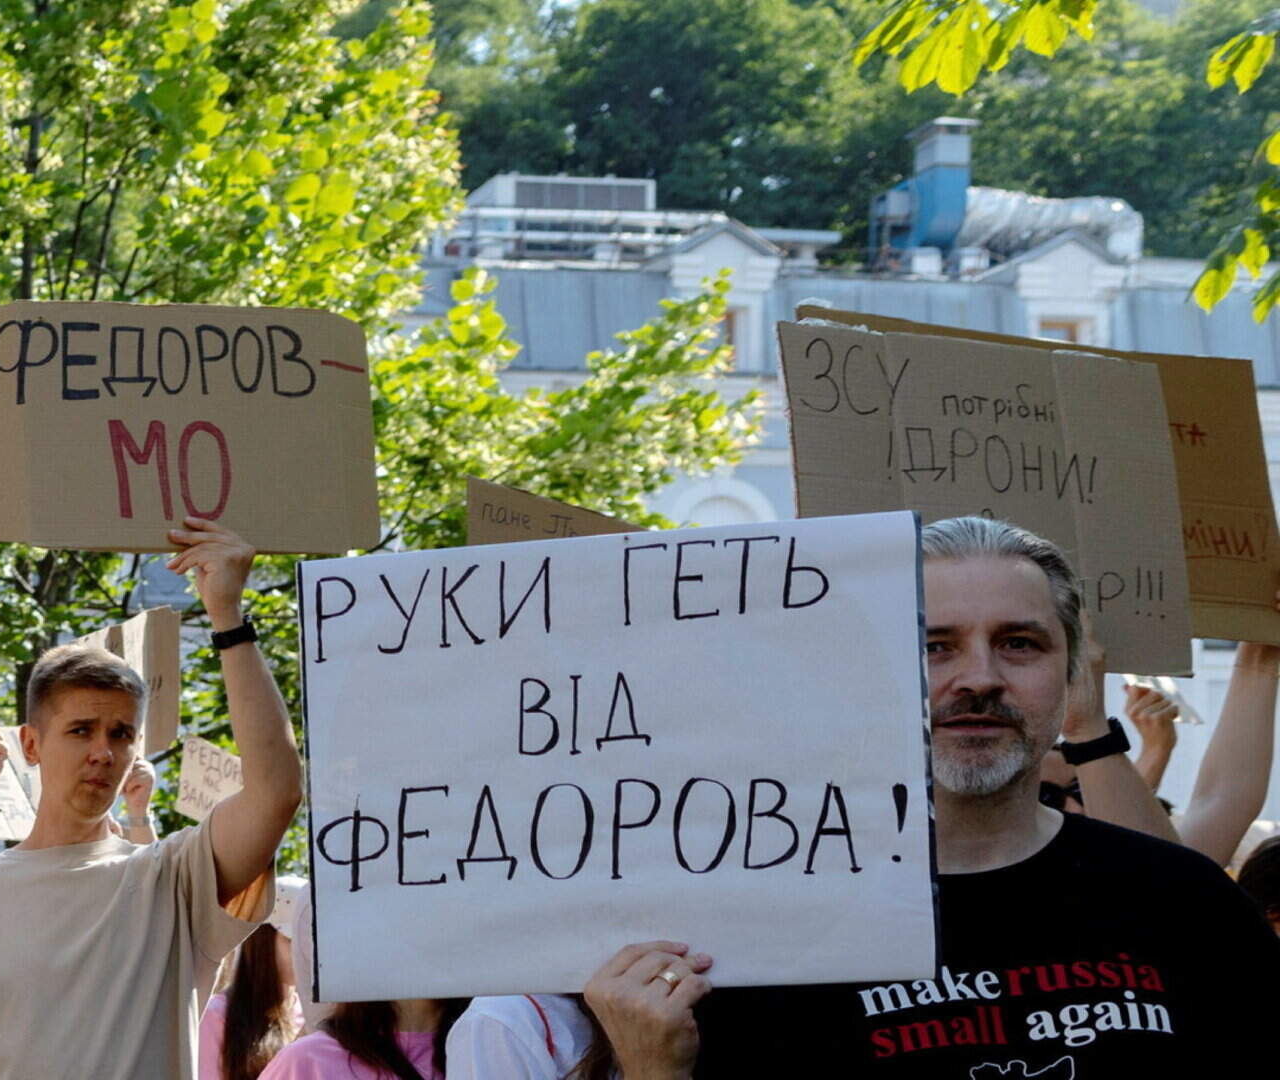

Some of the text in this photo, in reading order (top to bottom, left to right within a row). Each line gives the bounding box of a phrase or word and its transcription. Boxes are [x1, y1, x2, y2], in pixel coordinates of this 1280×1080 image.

[800, 338, 910, 415] ЗСУ
[108, 419, 232, 521] МО
[314, 536, 830, 663] РУКИ ГЕТЬ
[519, 671, 652, 755] ВІД
[316, 776, 908, 892] ФЕДОРОВА!
[858, 952, 1165, 1016] make russia
[870, 990, 1174, 1057] small again
